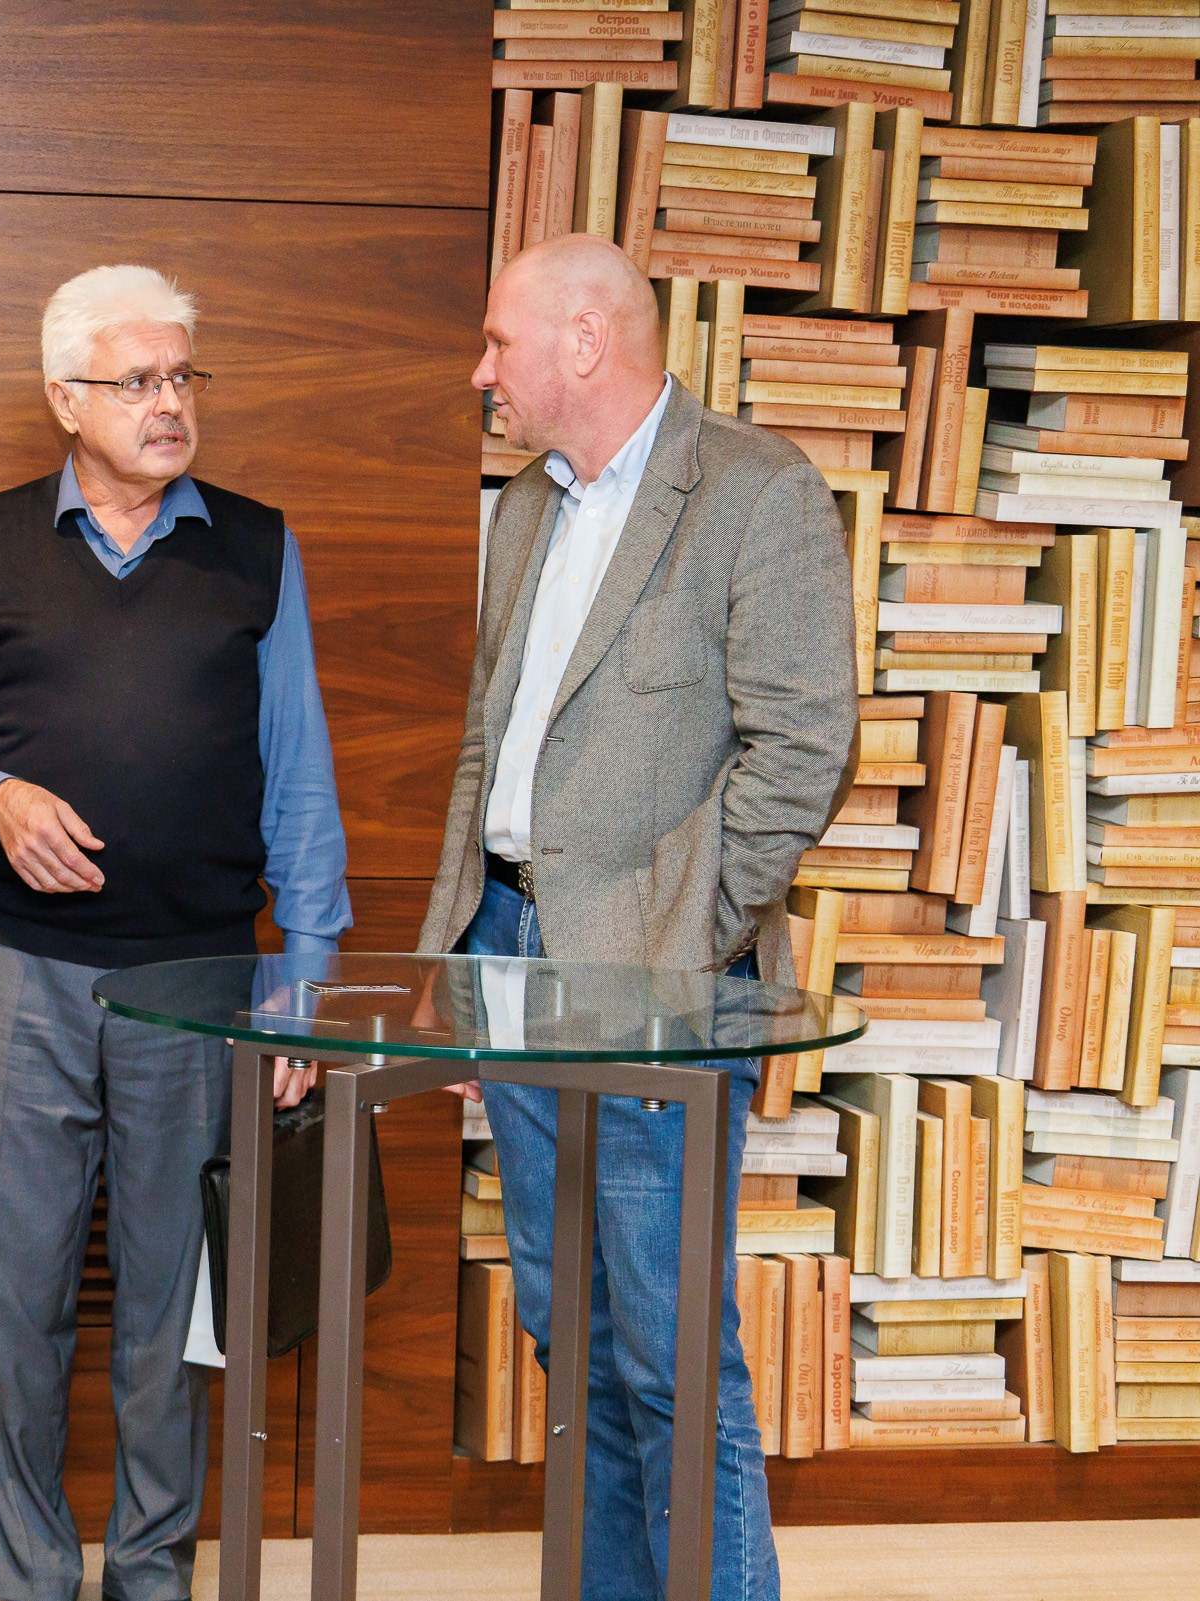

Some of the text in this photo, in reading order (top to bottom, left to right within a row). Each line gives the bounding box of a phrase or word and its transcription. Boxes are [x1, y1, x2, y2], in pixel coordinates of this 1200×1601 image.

[588, 26, 650, 37] сокровищ
[596, 14, 639, 26] Остров
[743, 10, 759, 75] о Мэгре
[569, 69, 585, 82] The
[586, 70, 604, 84] Lady
[605, 71, 615, 83] of
[615, 71, 629, 83] the
[629, 71, 649, 83] Lake
[854, 66, 892, 79] Fitzgerald
[998, 39, 1021, 86] Victory
[872, 91, 914, 107] Улисс
[730, 125, 749, 139] Сага
[761, 129, 809, 146] Форсайтах
[996, 139, 1073, 158] Повелитель мух
[534, 150, 546, 172] Zenda
[740, 160, 790, 172] Copperfield
[503, 160, 518, 209] Красное
[531, 180, 543, 210] Prisoner
[634, 207, 648, 240] The Old
[702, 216, 782, 232] Властелин колец
[846, 190, 863, 244] The Jungle
[499, 222, 512, 266] черное
[888, 220, 911, 279] Winterset
[1140, 210, 1153, 288] Troilus and Criseyde
[1158, 228, 1173, 271] Исповедь
[707, 264, 791, 280] Доктор Живаго
[988, 270, 1020, 281] Dickens
[985, 289, 1064, 303] Тени исчезают
[1008, 301, 1051, 312] полдень
[719, 338, 734, 348] G.
[718, 351, 733, 375] Wells
[943, 352, 956, 385] Scott
[953, 344, 968, 395] Michael
[1120, 356, 1136, 367] The
[1138, 357, 1175, 369] Stranger
[838, 411, 885, 426] Beloved
[939, 401, 955, 476] Tom Cringle's Log
[1077, 623, 1090, 656] Tartarin
[1104, 569, 1129, 692] George du Trilby
[1076, 670, 1090, 704] Tarascon
[951, 722, 966, 761] Random
[872, 767, 895, 781] Dick
[1050, 725, 1065, 804] Tartarin of Tarascon
[946, 761, 962, 804] Roderick
[940, 835, 952, 859] Tobias
[967, 801, 988, 867] Lady Into Fox
[1015, 834, 1025, 873] Christmas
[1021, 978, 1037, 1055] Anna Karenina
[1085, 1047, 1096, 1061] Tale
[1145, 1001, 1162, 1074] The Virginian
[863, 1138, 875, 1169] Faust
[949, 1169, 962, 1223] Скотный
[1178, 1173, 1195, 1212] Новеллы
[893, 1175, 910, 1246] Don Juan
[999, 1189, 1019, 1247] Winterset
[948, 1225, 960, 1254] двор
[1031, 1283, 1041, 1311] Андре
[795, 1362, 812, 1421] Our Town
[829, 1352, 843, 1425] Аэропорт
[1076, 1347, 1089, 1422] Troilus and Criseyde
